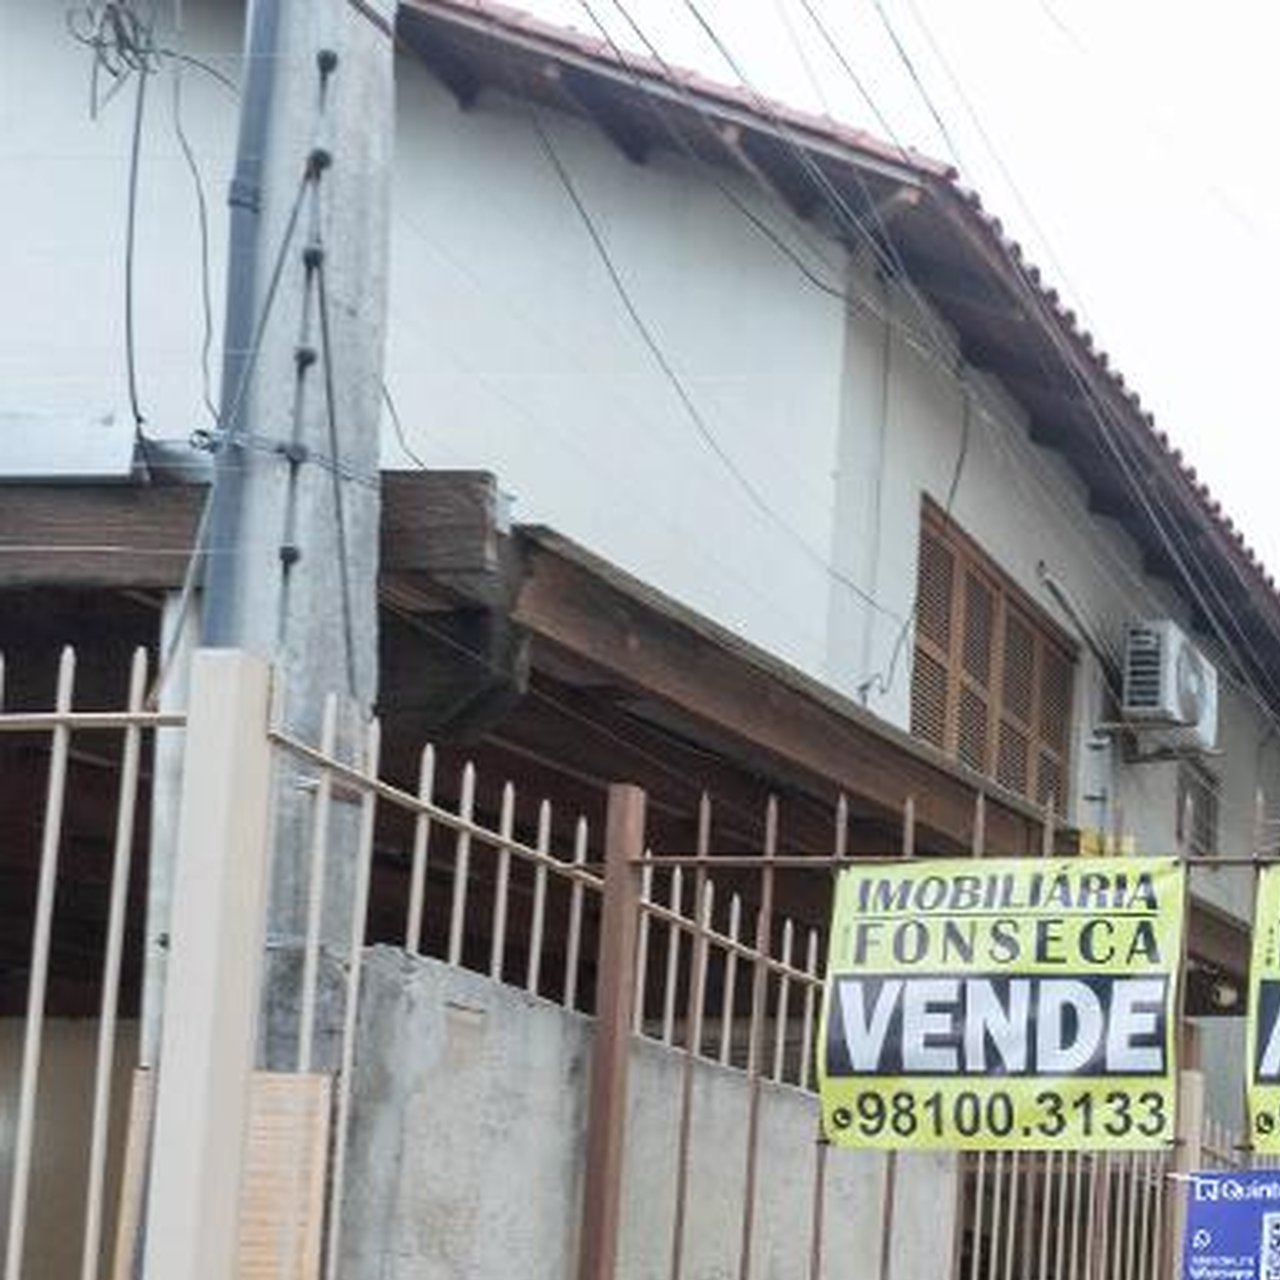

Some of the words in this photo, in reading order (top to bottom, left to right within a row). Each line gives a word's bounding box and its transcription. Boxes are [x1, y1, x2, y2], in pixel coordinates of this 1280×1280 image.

[857, 864, 1160, 912] IMOBILIÁRIA
[852, 918, 1163, 965] FONSECA
[837, 978, 1167, 1074] VENDE
[858, 1090, 1166, 1138] 98100.3133
